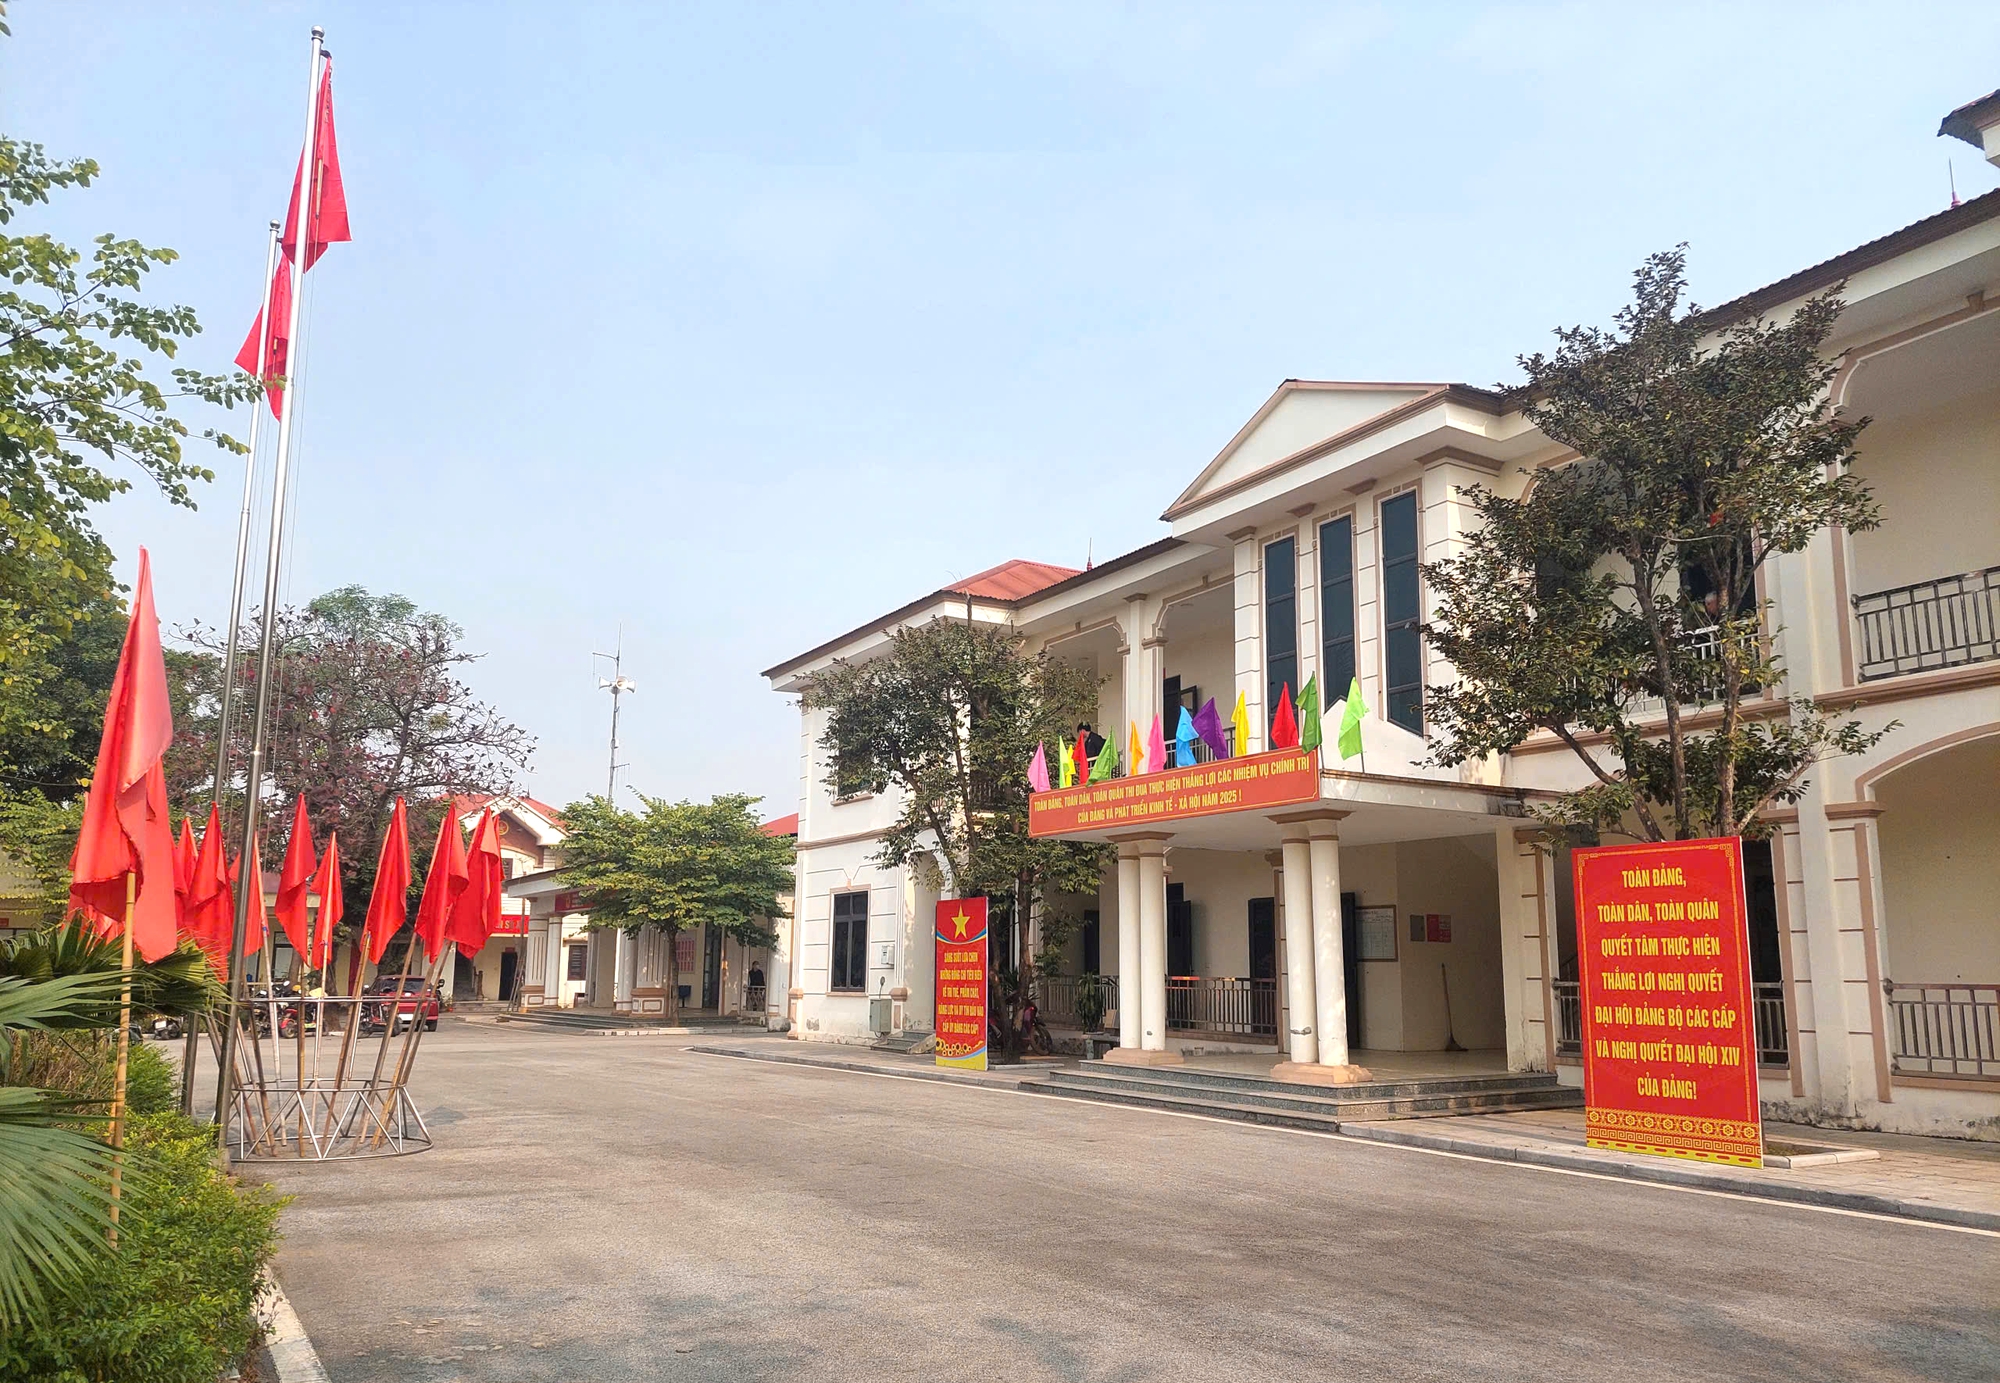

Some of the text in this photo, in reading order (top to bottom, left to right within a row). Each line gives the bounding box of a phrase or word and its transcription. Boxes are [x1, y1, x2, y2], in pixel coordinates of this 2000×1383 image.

[1182, 771, 1203, 789] THẮNG
[1206, 773, 1215, 788] LỢI
[1218, 769, 1231, 783] CÁC
[1234, 764, 1257, 781] NHIỆM
[1259, 762, 1269, 778] VỤ
[1271, 758, 1295, 774] CHÍNH
[1297, 756, 1309, 772] TRỊ
[1179, 798, 1187, 810] XÃ
[1189, 794, 1200, 810] HỘI
[1202, 791, 1218, 807] NĂM
[1220, 790, 1236, 803] 2025
[1622, 863, 1687, 888] TOÀN ĐẢNG,
[1598, 897, 1718, 923] TOÀN DÂN, TOÀN QUÂN
[1601, 934, 1720, 959] QUYẾT TÂM THỰC HIỆN
[1602, 967, 1723, 995] THẮNG LỢI NGHỊ QUYẾT
[1595, 1001, 1736, 1034] ĐẠI HỘI ĐẢNG BỘ CÁC CẤP
[1596, 1039, 1740, 1068] VÀ NGHỊ QUYẾT ĐẠI HỘI XIV
[1637, 1073, 1697, 1100] CỦA ĐẢNG!
